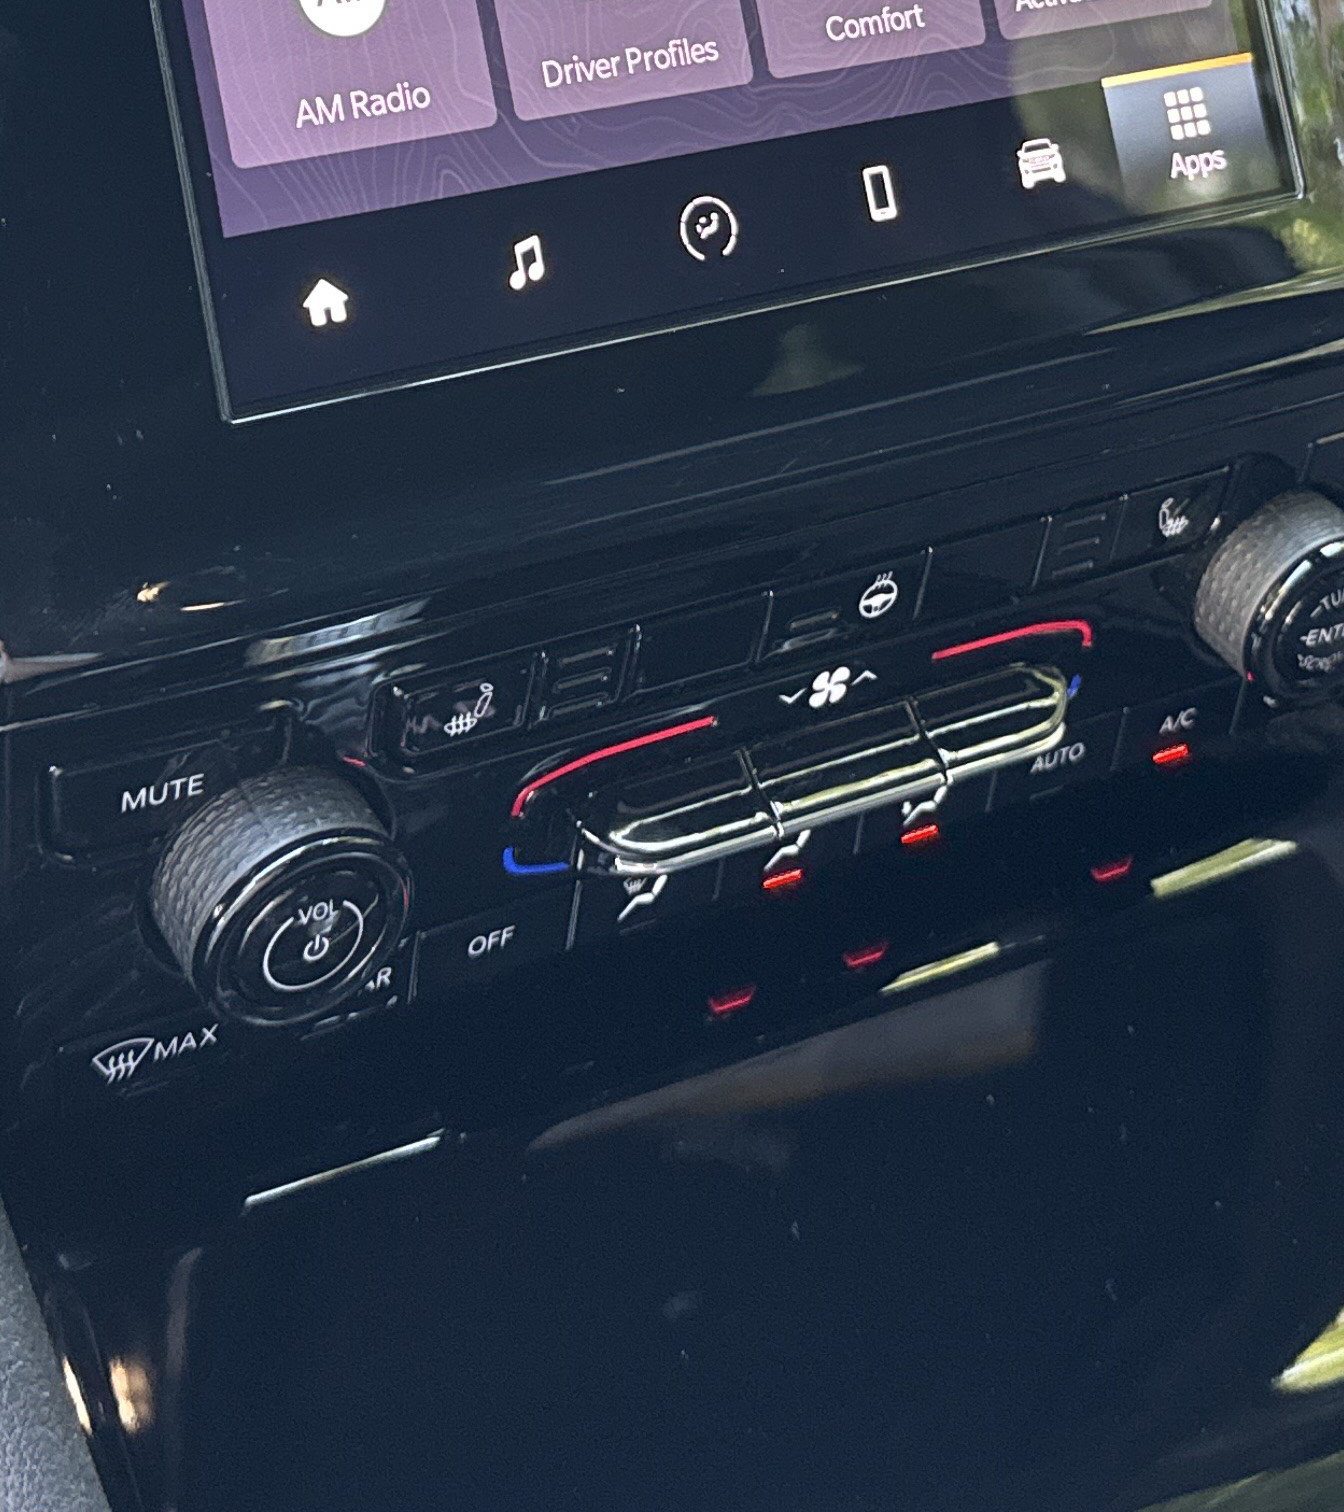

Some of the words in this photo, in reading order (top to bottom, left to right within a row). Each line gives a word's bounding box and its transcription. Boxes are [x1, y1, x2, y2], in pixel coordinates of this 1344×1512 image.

[825, 3, 926, 43] Comfort
[542, 52, 620, 89] Driver
[625, 37, 720, 76] Profiles
[295, 96, 346, 130] AM
[350, 82, 432, 120] Radio
[1170, 148, 1227, 181] Apps
[1159, 708, 1197, 733] A/C
[1030, 742, 1085, 774] AUTO
[121, 773, 205, 813] MUTE
[297, 899, 340, 926] VOL
[468, 925, 516, 958] OFF
[154, 1024, 219, 1061] MAX
